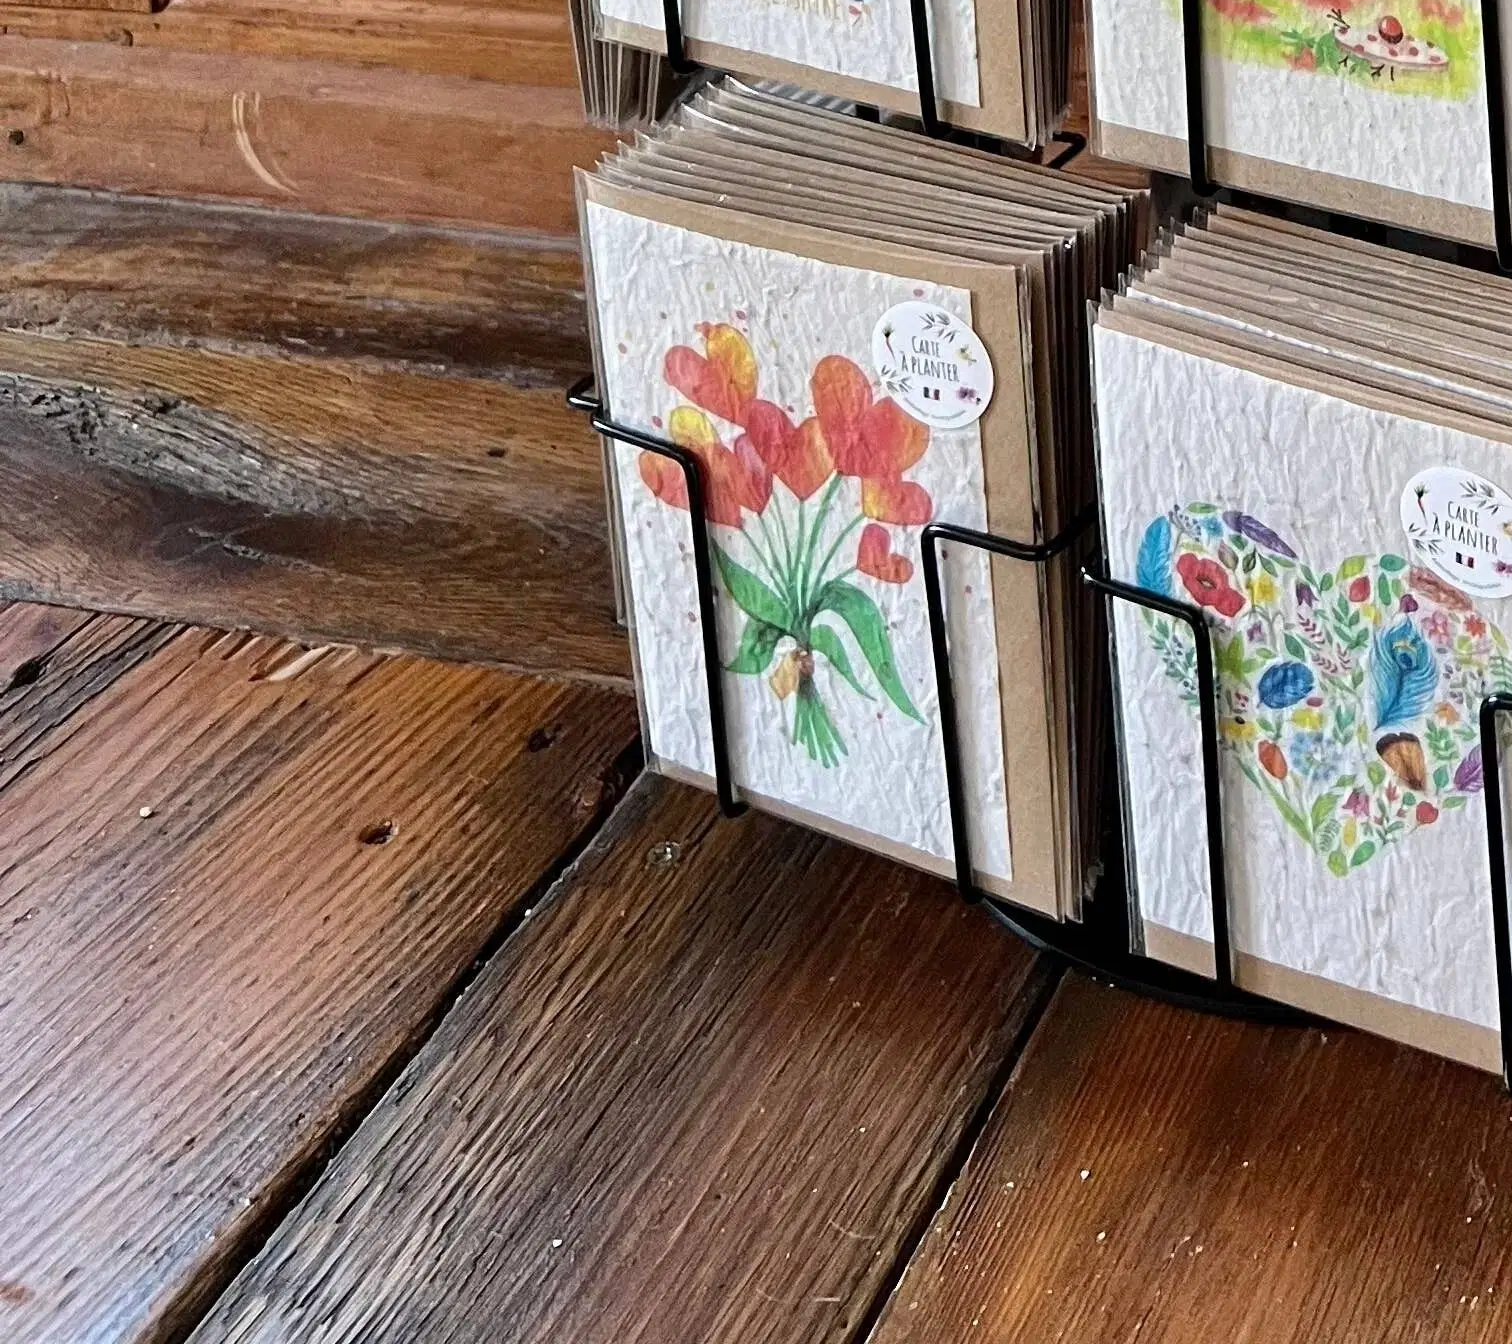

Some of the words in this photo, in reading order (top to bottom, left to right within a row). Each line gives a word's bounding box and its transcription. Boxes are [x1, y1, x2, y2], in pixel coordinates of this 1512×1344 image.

[911, 335, 941, 359] CARTE
[910, 356, 961, 383] PLANTER
[1447, 500, 1480, 528] CARTE
[1431, 511, 1441, 535] À
[1444, 519, 1499, 557] PLANTER
